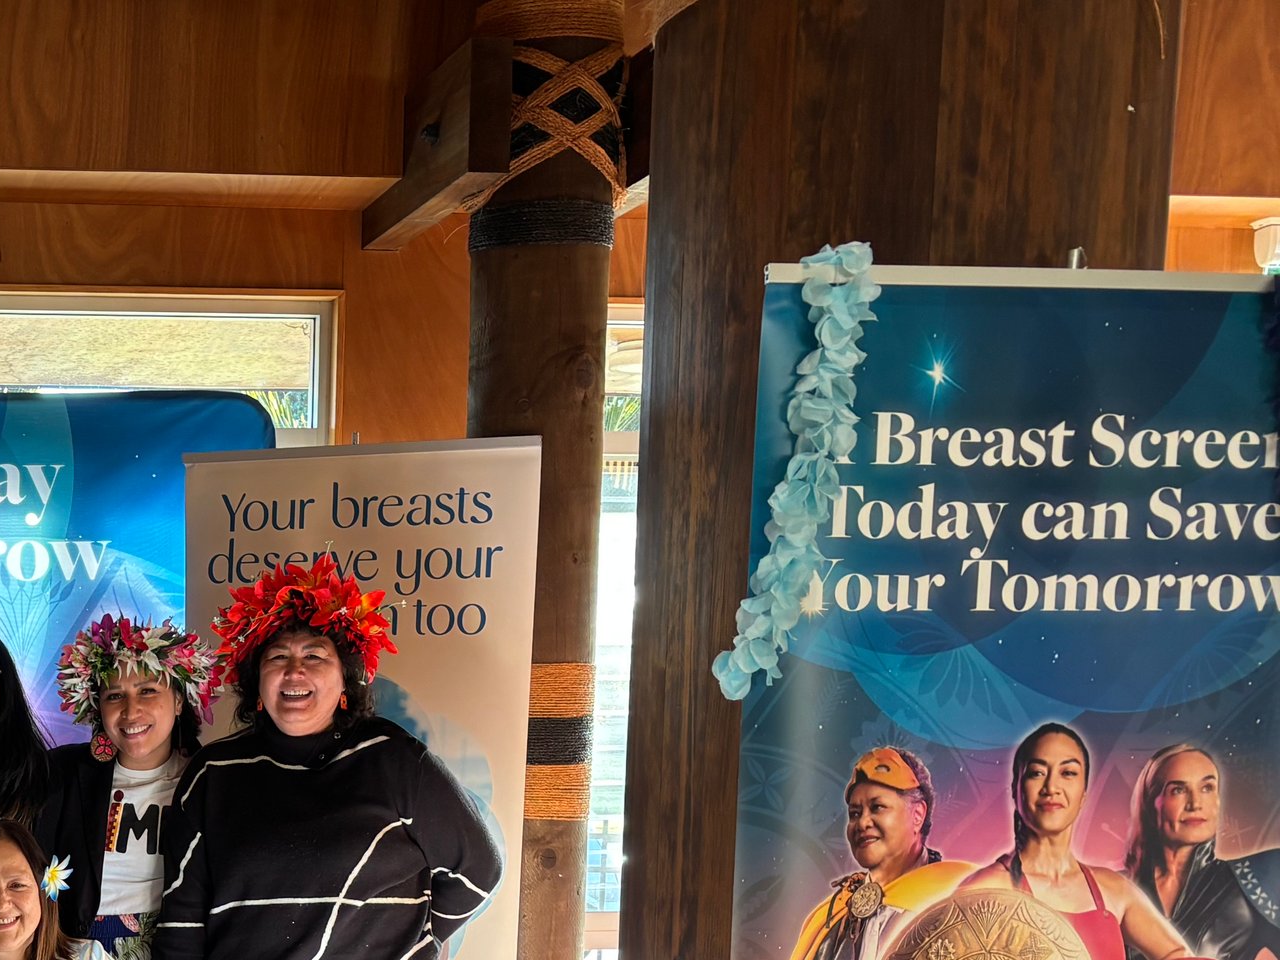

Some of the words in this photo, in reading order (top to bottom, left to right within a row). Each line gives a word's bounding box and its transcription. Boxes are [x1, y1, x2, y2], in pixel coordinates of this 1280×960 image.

[870, 411, 1076, 468] Breast
[221, 492, 316, 532] Your
[331, 481, 493, 528] breasts
[825, 482, 1010, 560] Today
[1020, 499, 1131, 541] can
[1146, 486, 1280, 541] Save
[394, 545, 504, 596] your
[960, 559, 1280, 613] Tomorrow
[413, 600, 487, 637] too
